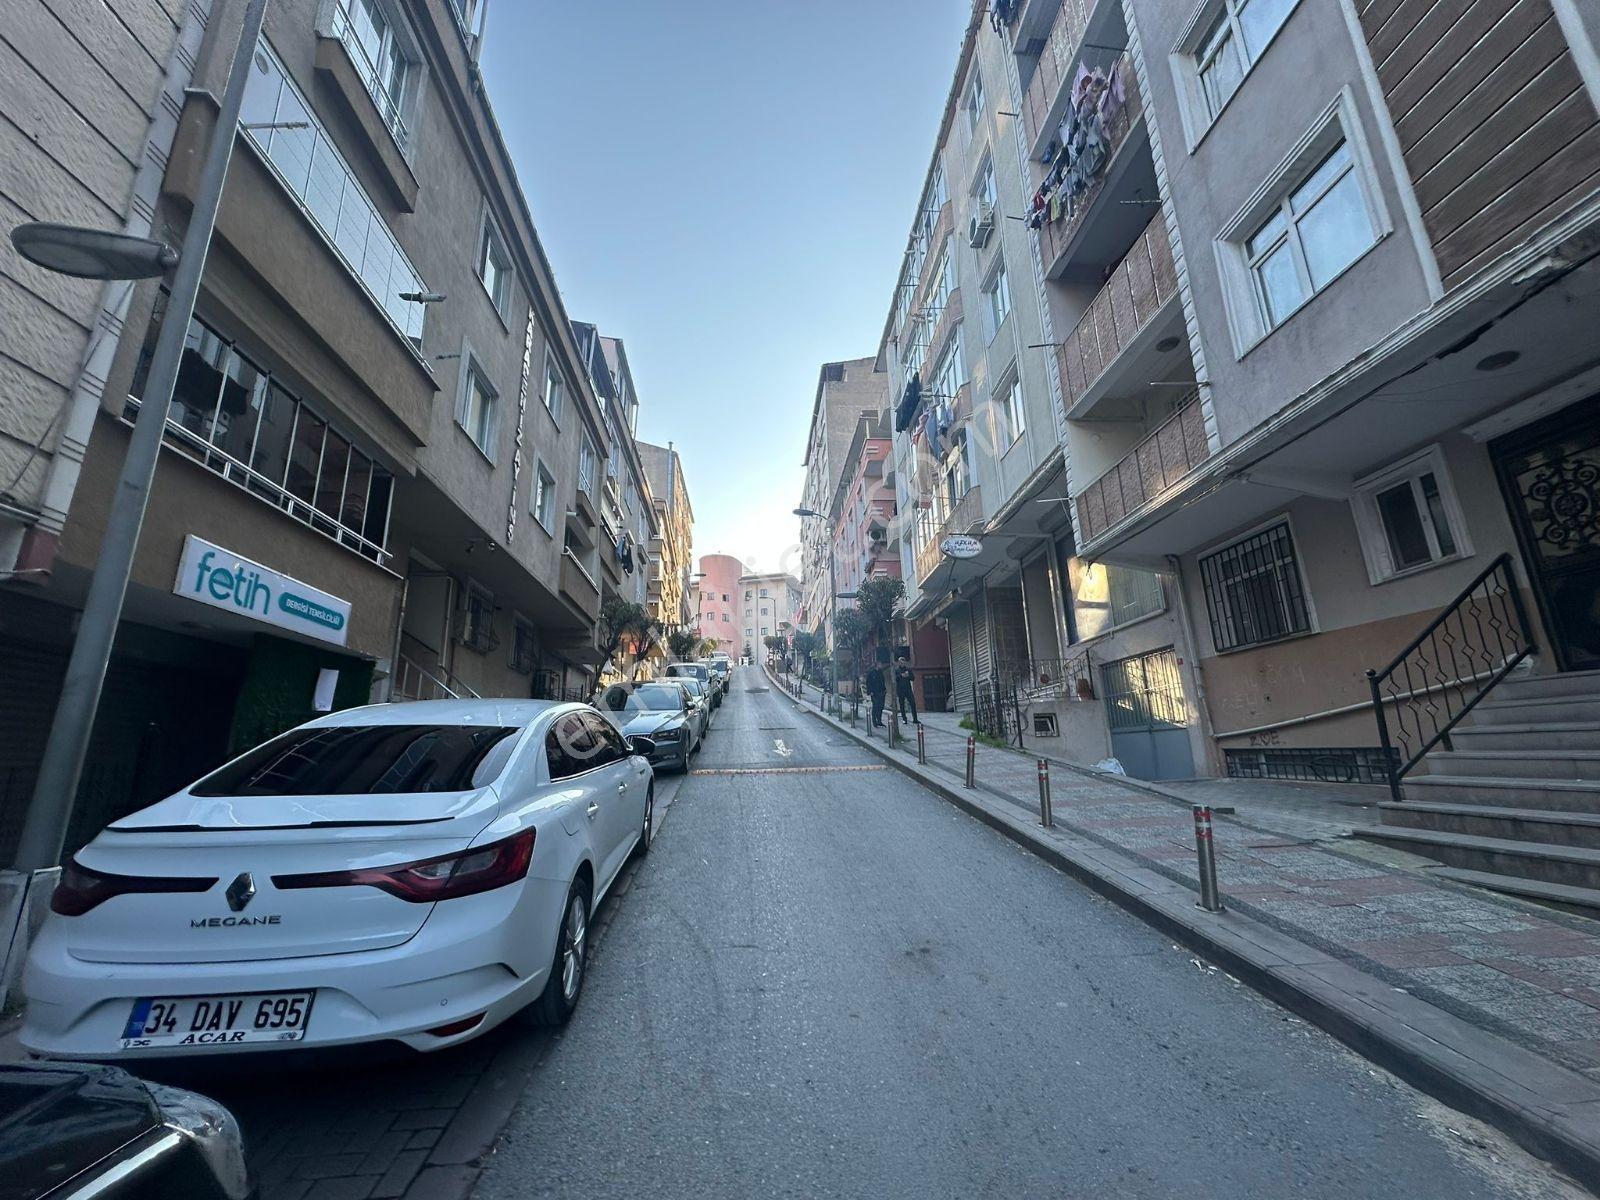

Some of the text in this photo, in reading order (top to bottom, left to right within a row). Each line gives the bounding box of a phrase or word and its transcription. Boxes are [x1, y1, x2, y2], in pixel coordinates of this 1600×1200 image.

[516, 304, 535, 447] KARADENİZ
[194, 551, 271, 615] fetih
[190, 914, 282, 929] MEGANE
[144, 997, 305, 1034] 34 DAV 695
[180, 1031, 246, 1044] ACAR
